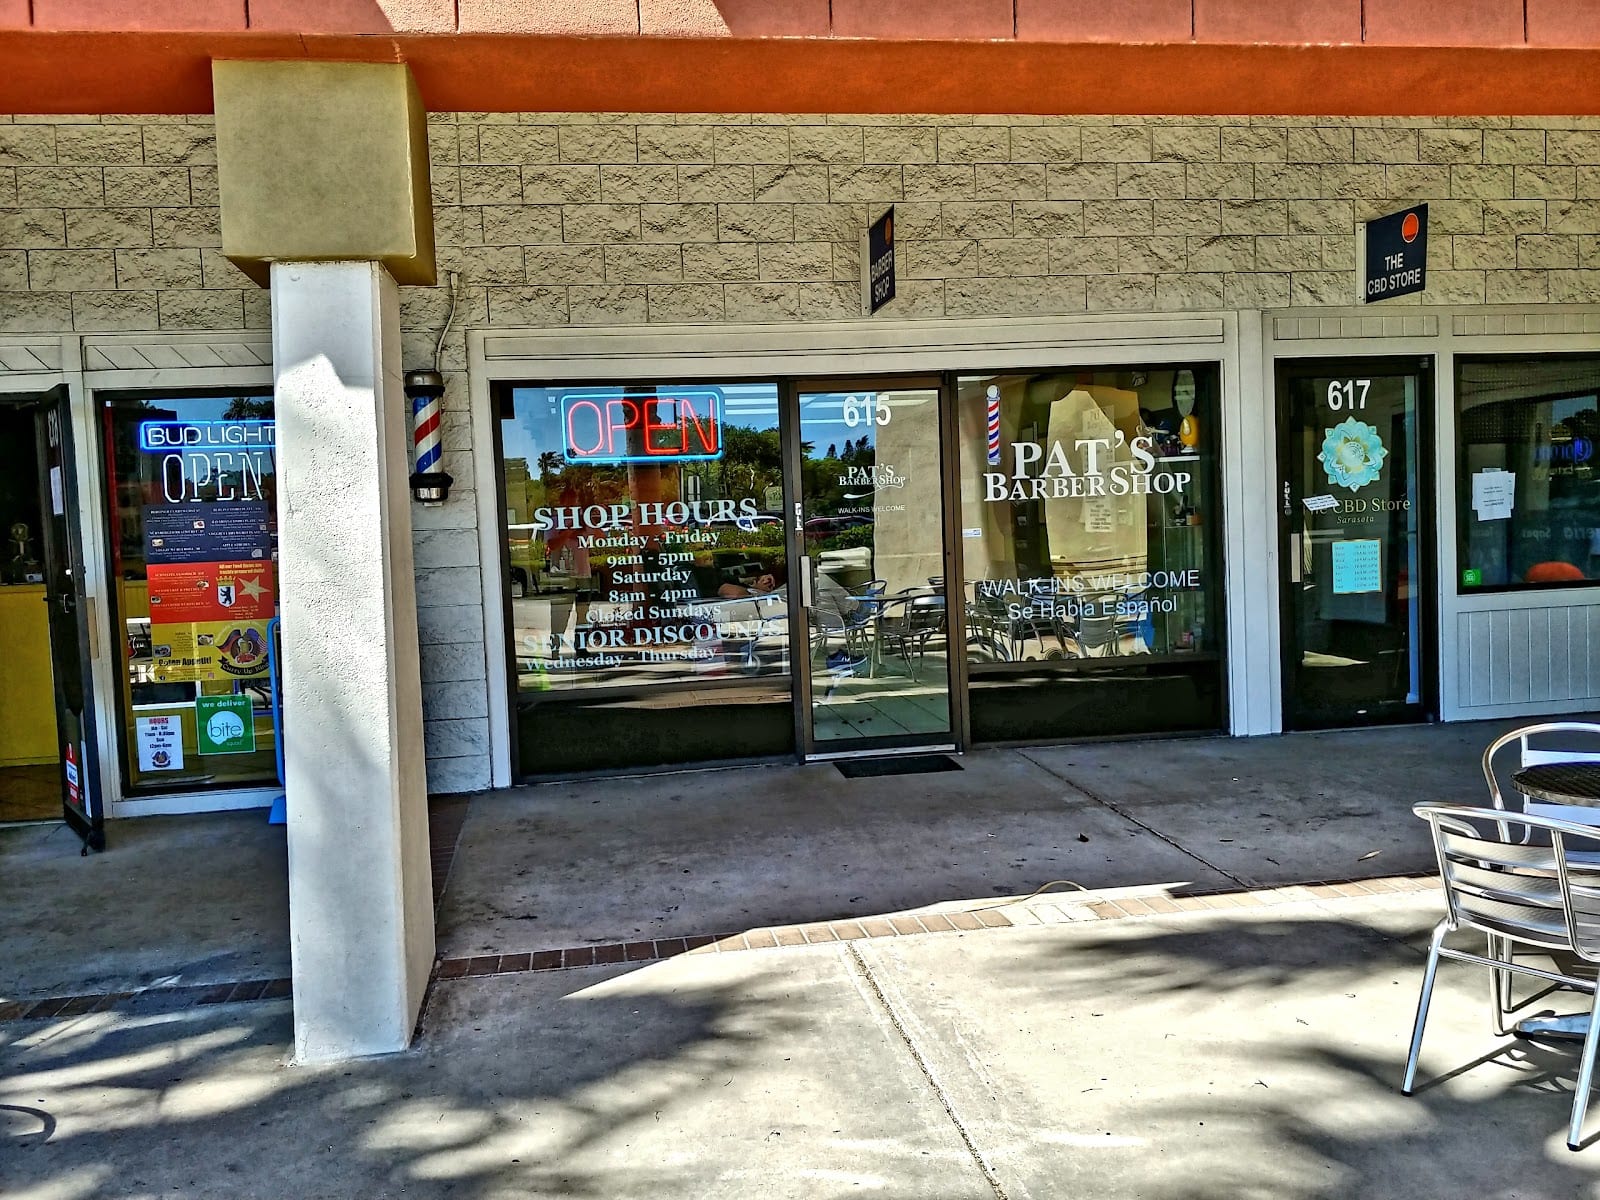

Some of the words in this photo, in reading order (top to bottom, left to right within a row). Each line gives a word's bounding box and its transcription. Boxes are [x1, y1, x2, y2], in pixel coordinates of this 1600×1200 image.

[871, 250, 893, 283] BARBER
[1384, 252, 1404, 271] THE
[874, 276, 890, 303] SHOP
[1367, 277, 1388, 295] CBD
[1388, 267, 1421, 290] STORE
[1327, 379, 1371, 411] 617
[843, 395, 892, 427] 615
[147, 426, 202, 445] BUD
[207, 425, 276, 444] LIGHT
[567, 398, 717, 456] OPEN
[1010, 430, 1156, 480] PAT'S
[163, 452, 265, 503] OPEN
[847, 463, 894, 479] PAT'S
[533, 502, 630, 531] SHOP
[637, 497, 758, 526] HOURS
[794, 502, 804, 531] PULL
[838, 505, 870, 514] WALK-INS
[871, 504, 906, 513] WELCOME
[1333, 498, 1367, 514] CBD
[1371, 497, 1411, 511] Store
[1336, 515, 1375, 524] Sarasota
[577, 532, 650, 550] Monday
[664, 528, 721, 546] Friday
[606, 554, 644, 568] 9am
[657, 550, 695, 566] 5pm
[612, 567, 692, 585] Saturday
[982, 576, 1085, 597] WALK-INS
[1090, 569, 1200, 592] WELCOME
[608, 590, 646, 604] 8am
[659, 588, 698, 605] 4pm
[1008, 602, 1033, 620] Se
[1040, 601, 1095, 618] Habla
[1102, 595, 1178, 616] Español
[585, 604, 644, 624] Closed
[648, 602, 722, 622] Sundays
[523, 629, 626, 654] SENIOR
[633, 619, 781, 647] DISCOUNTS
[526, 653, 624, 672] Wednesday
[637, 646, 718, 664] Thursday
[217, 699, 246, 708] deliver
[209, 719, 242, 738] bite
